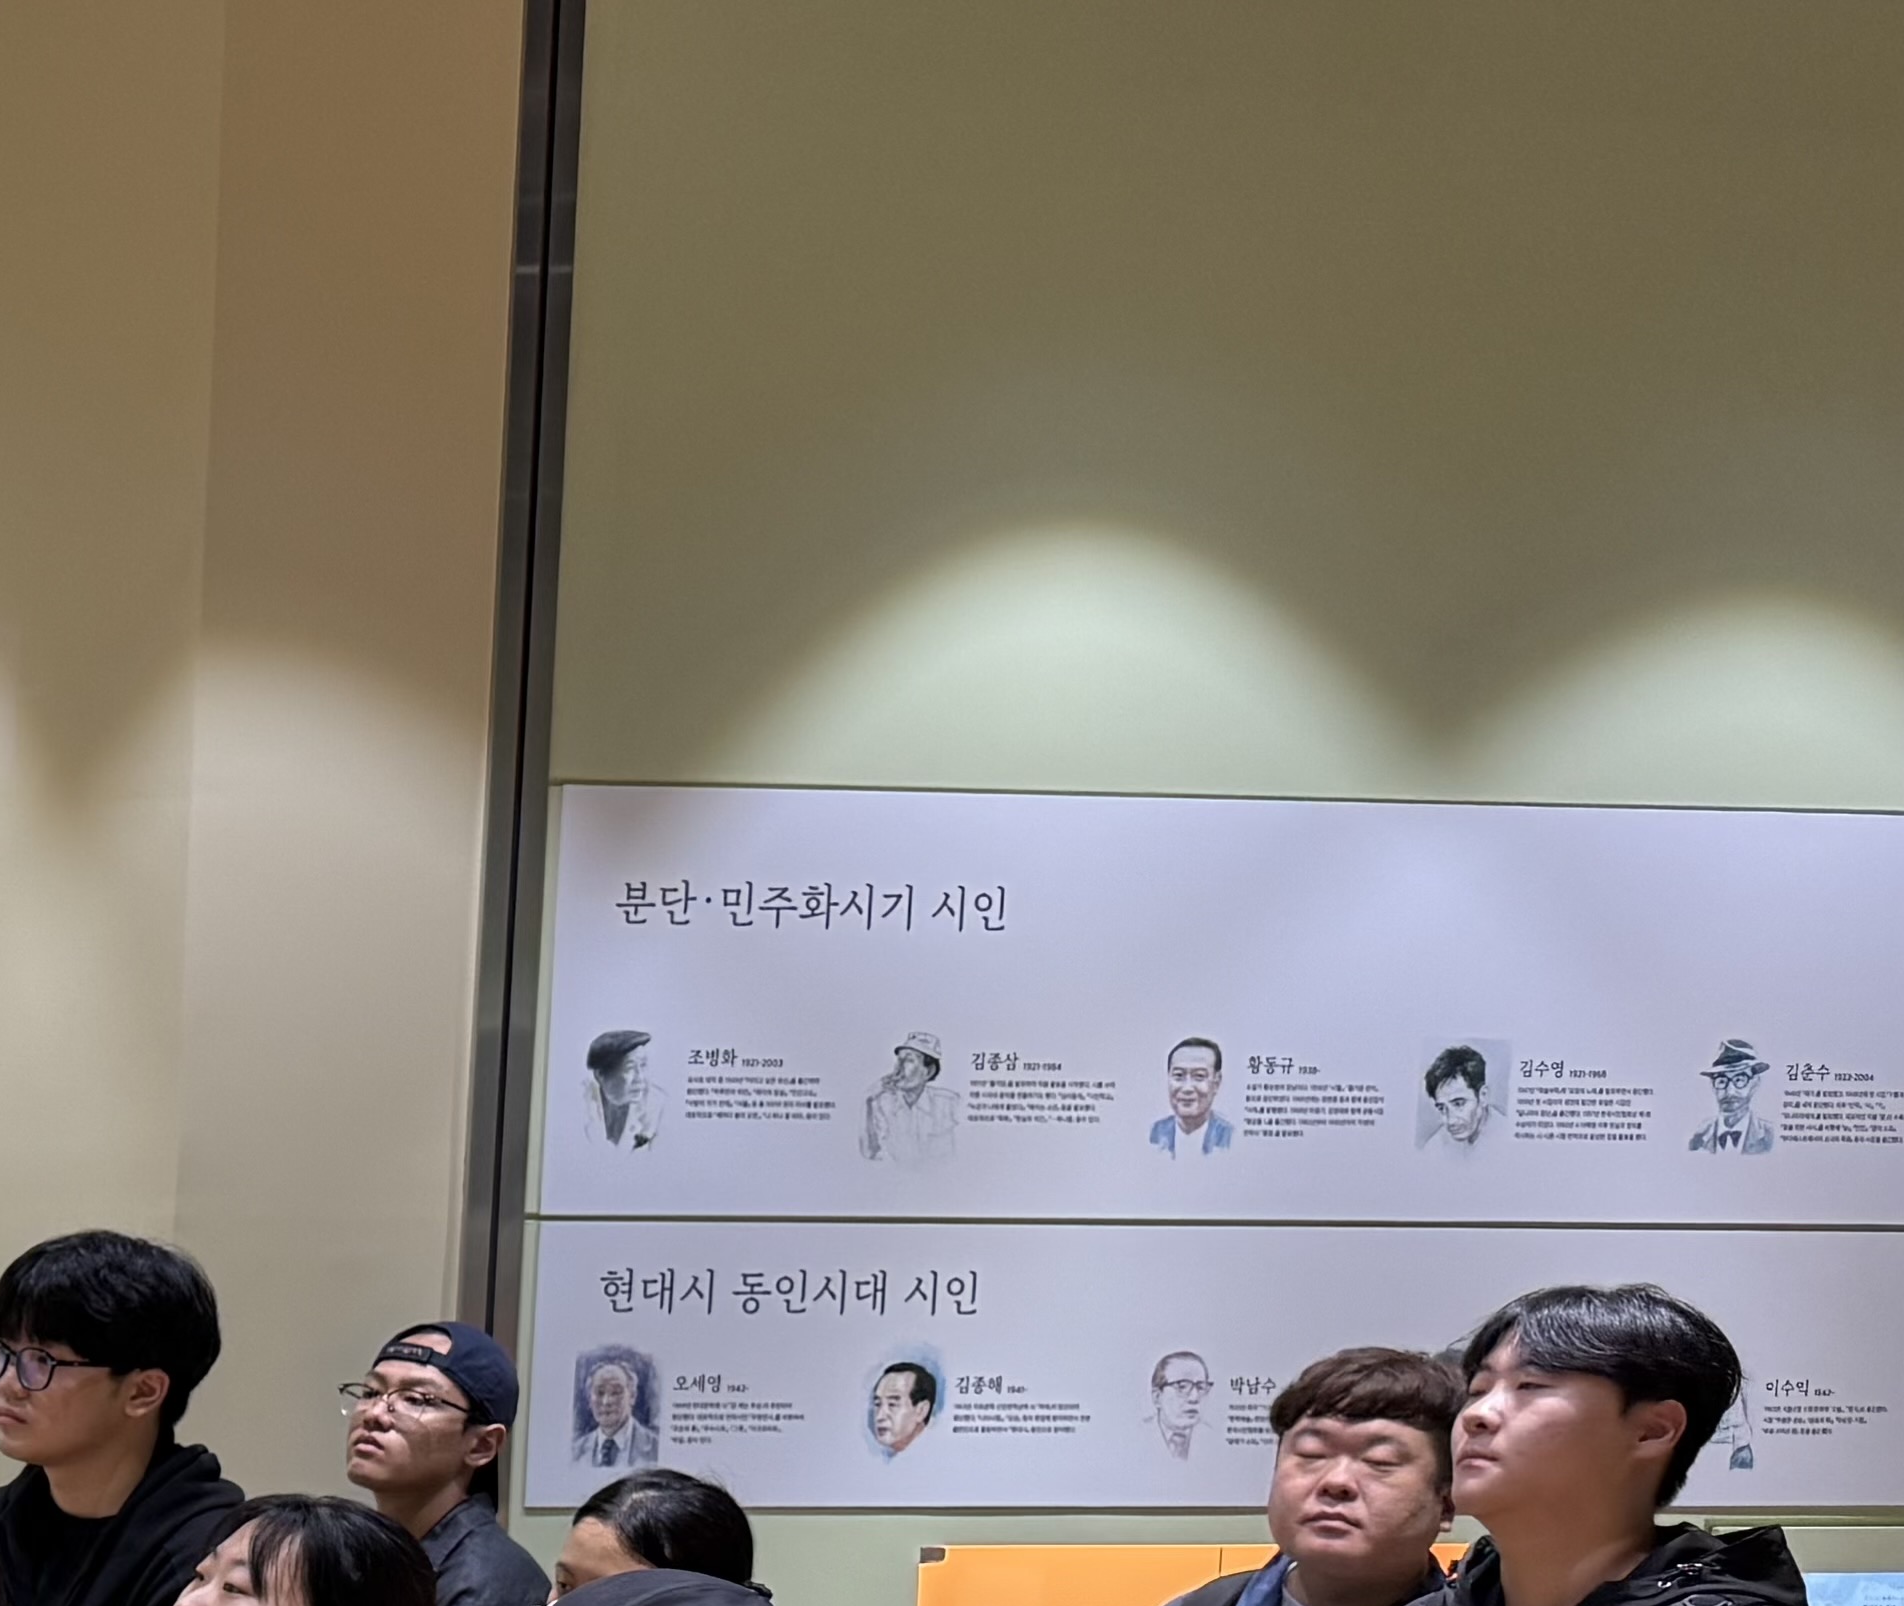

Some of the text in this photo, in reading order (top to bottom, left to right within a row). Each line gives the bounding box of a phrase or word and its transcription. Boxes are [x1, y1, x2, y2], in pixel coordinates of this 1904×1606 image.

[613, 876, 1010, 936] 분단·민주화시기 시인
[971, 1052, 1019, 1071] 김종삼
[1247, 1055, 1294, 1075] 황동규
[1520, 1059, 1565, 1078] 김수영
[1786, 1063, 1830, 1082] 김춘수
[599, 1262, 981, 1319] 현대시 동인시대 시인
[673, 1373, 721, 1393] 오세영
[955, 1375, 1003, 1395] 김종해
[1230, 1376, 1276, 1395] 박남수
[1766, 1379, 1809, 1397] 이수익
